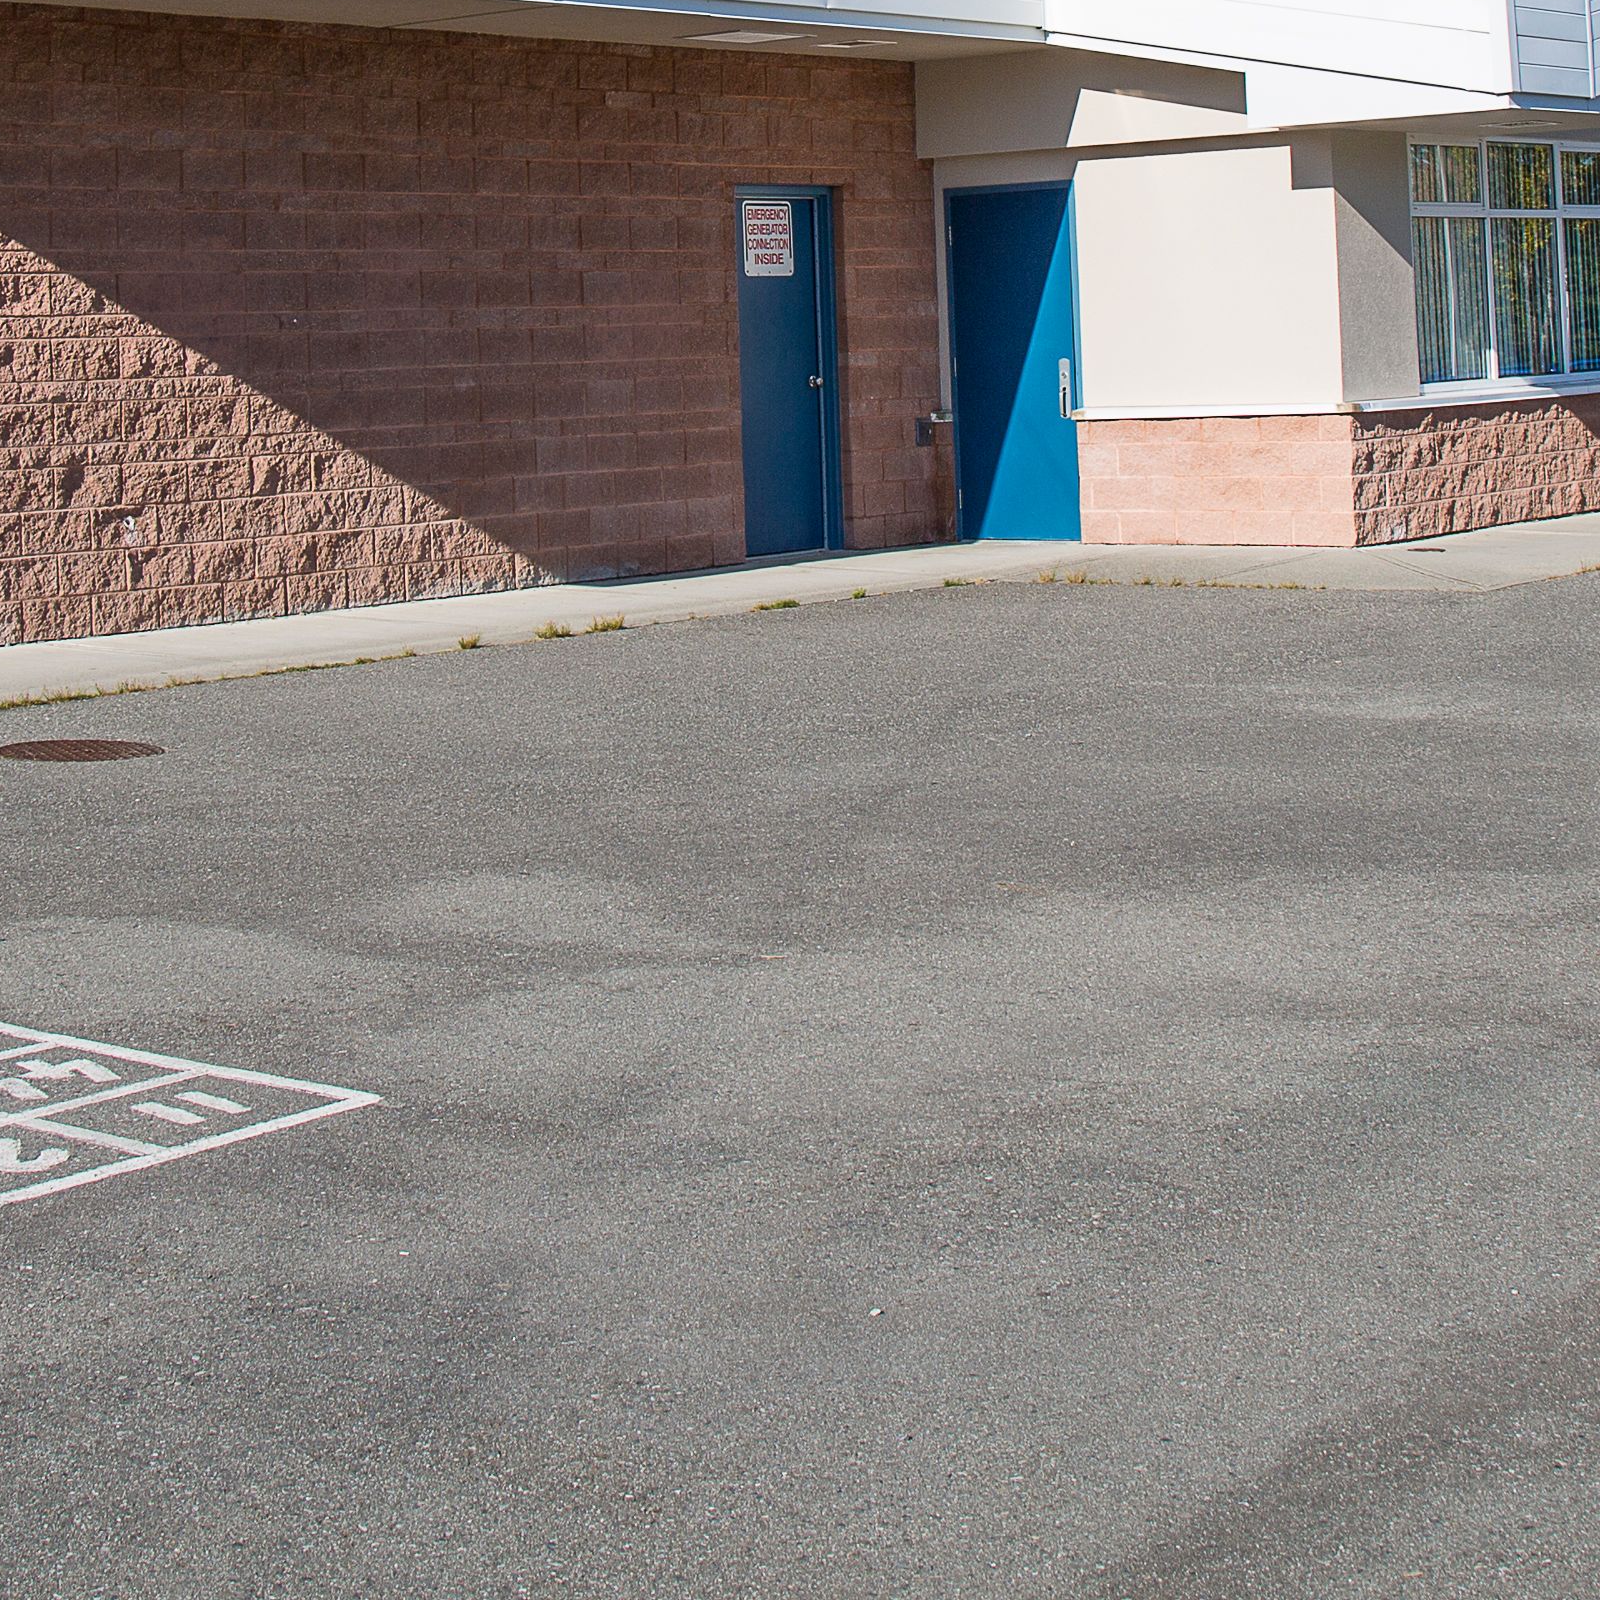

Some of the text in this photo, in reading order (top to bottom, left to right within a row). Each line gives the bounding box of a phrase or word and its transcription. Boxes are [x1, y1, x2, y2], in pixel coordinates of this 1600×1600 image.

[747, 208, 788, 220] EMERGENCY
[747, 223, 789, 236] GENERATOR
[747, 238, 789, 250] CONNECTION
[754, 253, 785, 265] INSIDE
[132, 1092, 248, 1124] 11
